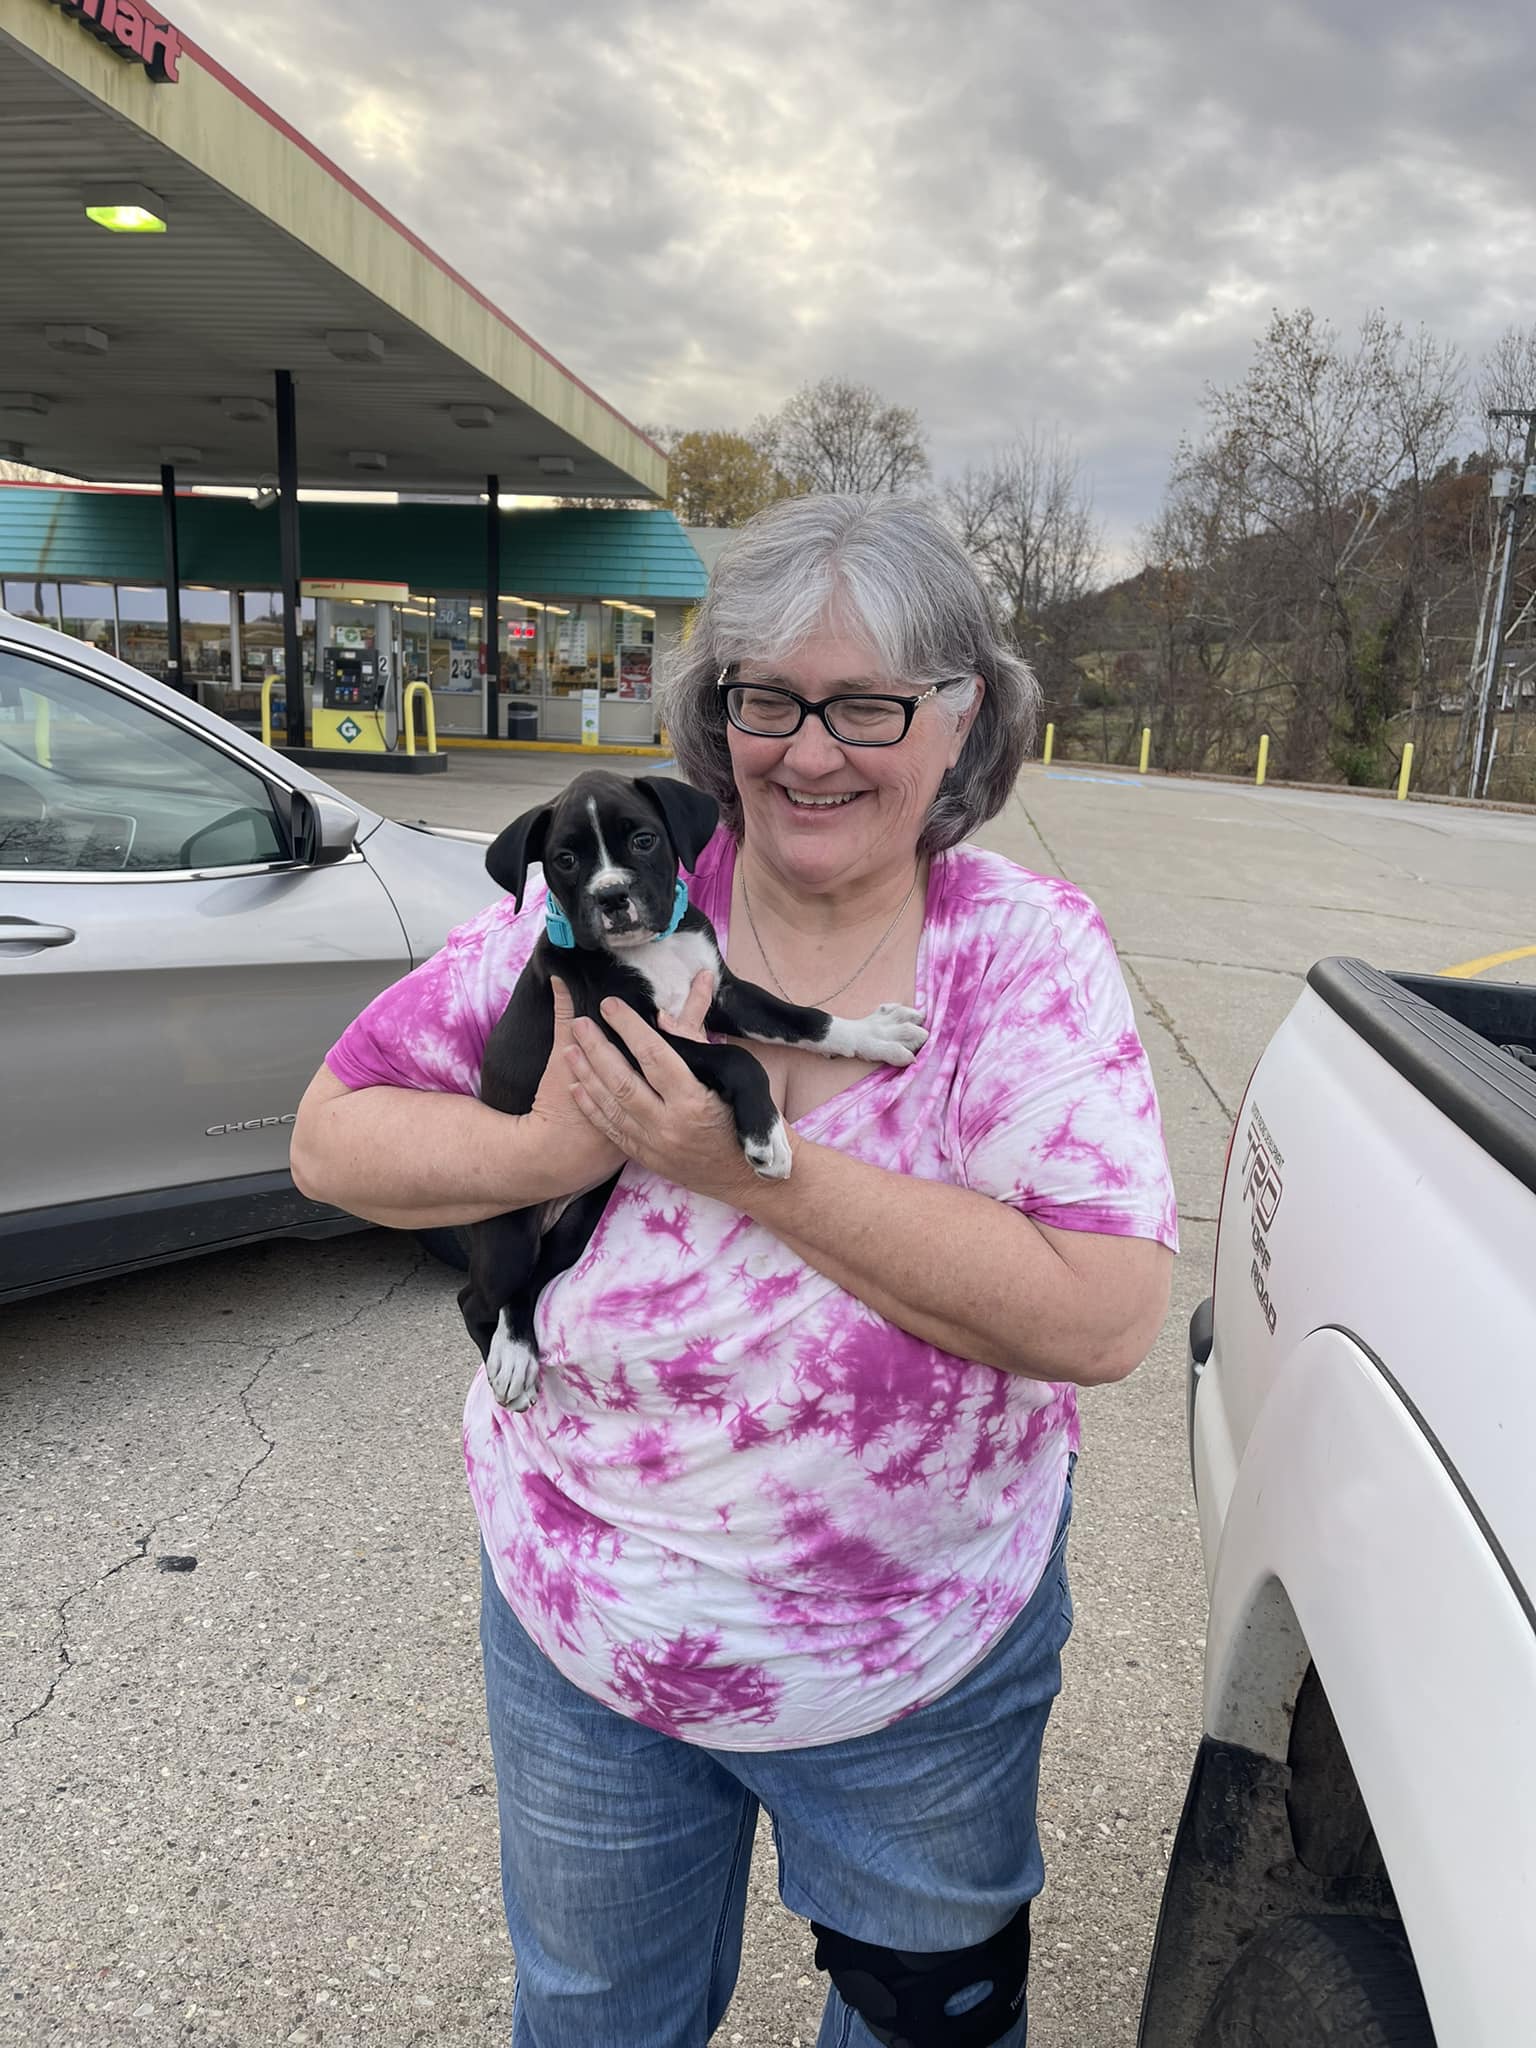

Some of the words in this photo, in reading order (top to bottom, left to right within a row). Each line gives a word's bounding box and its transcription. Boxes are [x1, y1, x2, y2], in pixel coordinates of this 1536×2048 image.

[380, 657, 388, 673] 2
[341, 722, 357, 738] G
[1242, 1121, 1283, 1233] TRD
[1251, 1223, 1271, 1272] OFF
[1250, 1259, 1277, 1336] ROAD
